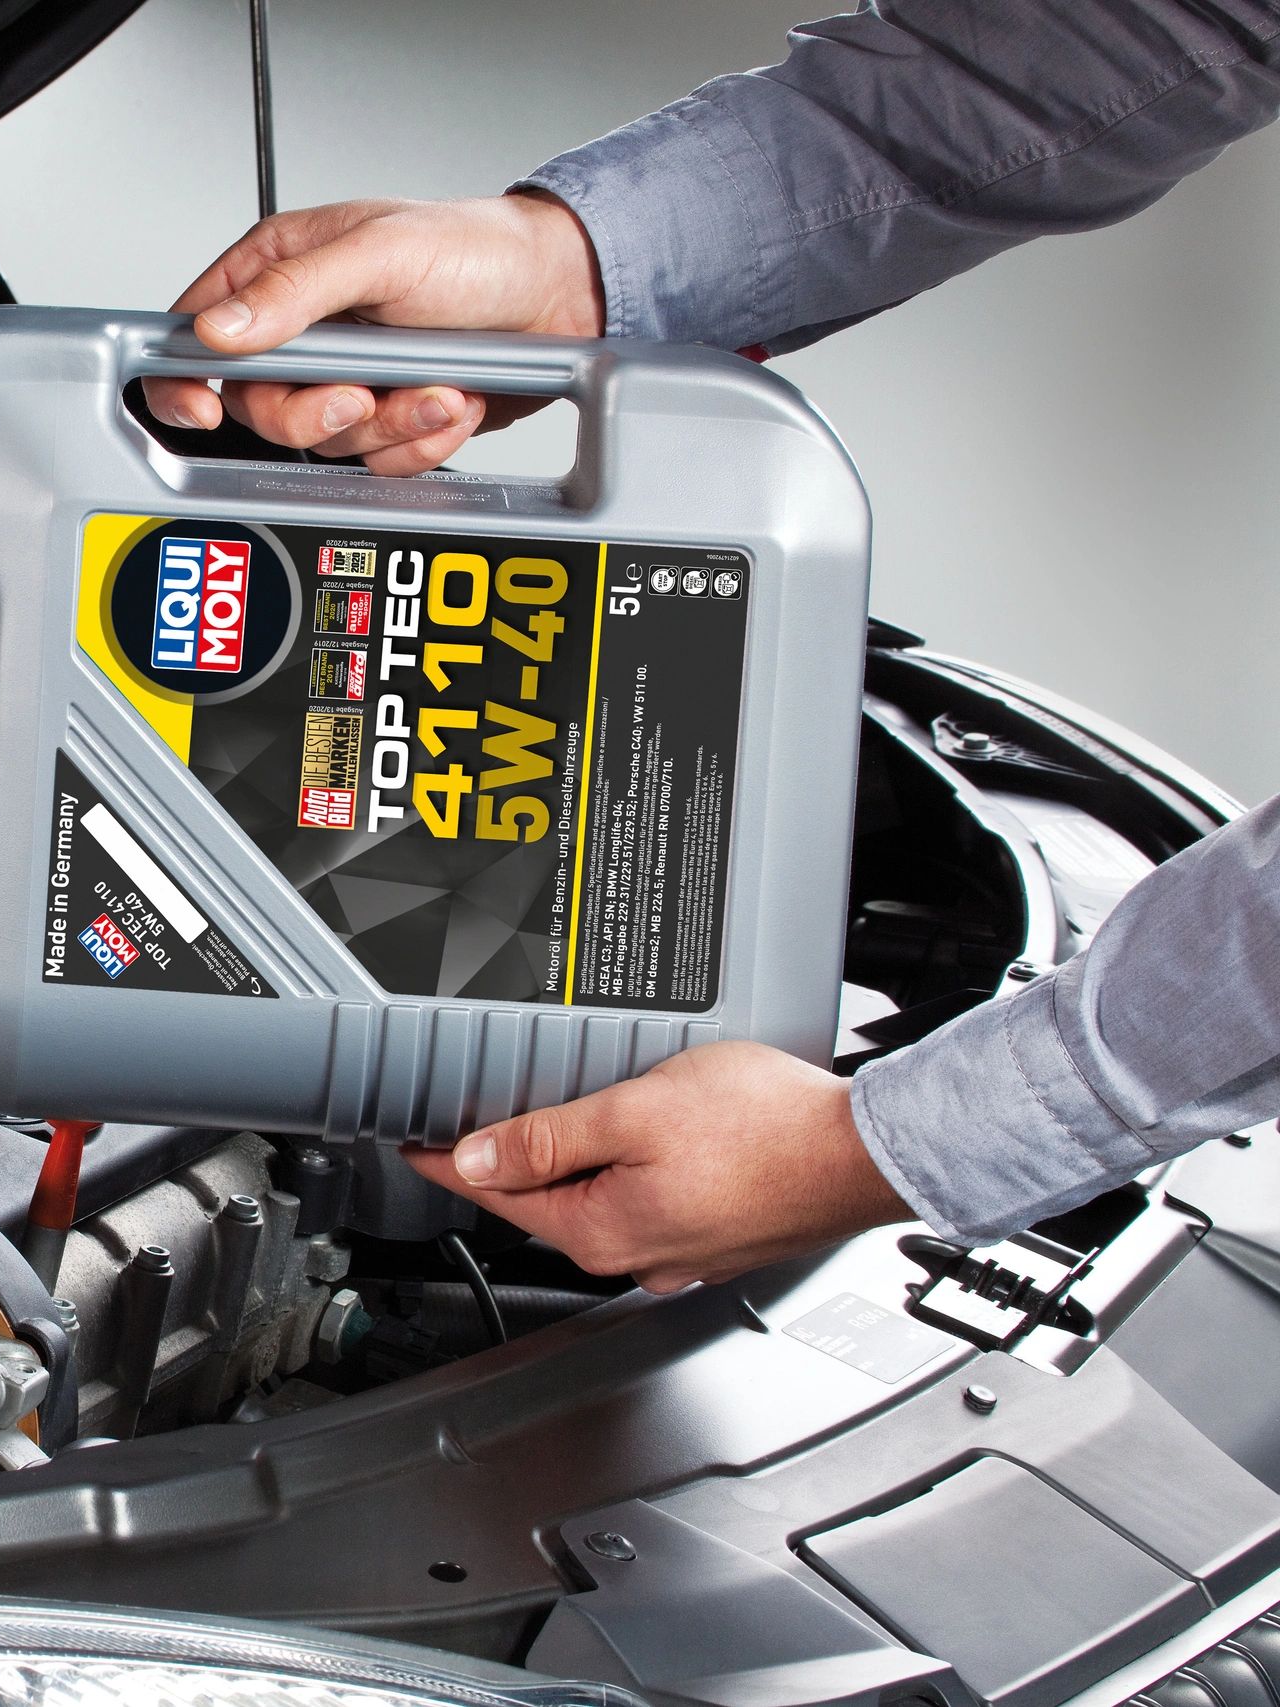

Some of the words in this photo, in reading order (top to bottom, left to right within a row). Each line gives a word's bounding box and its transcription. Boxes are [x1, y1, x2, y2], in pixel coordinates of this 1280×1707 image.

[349, 540, 377, 548] Ausgabe
[333, 552, 345, 572] TOP
[351, 553, 360, 573] 2020
[346, 582, 373, 590] Ausgabe
[157, 545, 204, 662] LIQUI
[200, 544, 246, 665] MOLY
[349, 602, 358, 632] auto
[380, 550, 425, 682] TEC
[342, 641, 368, 649] Ausgabe
[320, 652, 328, 676] BRAND
[352, 654, 365, 697] auto
[636, 664, 647, 681] 00.
[410, 552, 491, 840] 4110
[475, 556, 570, 844] 5W-40
[634, 684, 646, 703] 511
[599, 701, 608, 748] autorizzazioni
[633, 704, 644, 723] VW
[305, 715, 333, 763] BESTEN
[329, 717, 351, 788] MARKEN
[350, 718, 360, 754] KLASSEN
[631, 726, 644, 750] C40;
[348, 755, 358, 779] ALLEN
[368, 694, 413, 834] TOP
[595, 754, 604, 789] Specifiche
[644, 737, 654, 774] Aggregate,
[651, 751, 660, 783] gefordert
[303, 766, 329, 787] DIE
[347, 781, 356, 789] IN
[558, 722, 580, 830] Dieselfahrzeuge
[627, 752, 640, 797] Porsche
[659, 758, 674, 812] 0700/710.
[303, 789, 329, 826] Auto
[328, 792, 352, 824] Bild
[593, 794, 601, 827] approvals
[601, 779, 610, 824] autorizações:
[640, 791, 650, 827] Fahrzeuge
[608, 800, 625, 867] Longlife-04;
[643, 784, 657, 875] Originalersatzteilnummern
[658, 814, 669, 831] RN
[50, 792, 79, 888] Germany
[557, 833, 569, 858] und
[595, 830, 606, 879] Especificações
[637, 839, 645, 873] zusätzlich
[654, 833, 668, 876] Renault
[587, 841, 598, 888] Specifications
[617, 800, 638, 922] 229.31/229.51/229.52;
[94, 881, 125, 913] 4110
[551, 862, 567, 913] Benzin-
[606, 868, 618, 898] BMW
[634, 874, 643, 901] Produkt
[651, 879, 666, 912] 226.5;
[49, 894, 68, 913] in
[125, 893, 165, 937] 5W-40
[584, 893, 594, 928] Freigaben
[592, 884, 602, 934] autorizaciones
[604, 900, 617, 920] SN;
[633, 902, 641, 924] dieses
[638, 892, 649, 944] Spezifikationen
[122, 913, 148, 942] TEC
[550, 916, 563, 936] für
[602, 922, 614, 942] API
[650, 915, 661, 933] MB
[45, 918, 67, 977] Made
[81, 929, 123, 975] LIQUI
[94, 919, 136, 964] MOLY
[145, 943, 171, 970] TOP
[601, 944, 613, 962] C3;
[631, 925, 639, 958] empfiehlt
[647, 935, 661, 978] dexos2;
[225, 958, 235, 969] hier
[234, 968, 246, 980] Bitte
[235, 959, 250, 976] Please
[545, 940, 561, 991] Motoröl
[579, 942, 589, 994] Spezifikationen
[586, 939, 597, 995] Especificaciones
[612, 924, 628, 996] MB-Freigabe
[628, 958, 636, 977] MOLY
[636, 944, 645, 974] folgende
[214, 970, 233, 991] Nächster
[227, 974, 238, 987] Next
[598, 964, 611, 996] ACEA
[627, 978, 635, 997] LIQUI
[645, 980, 656, 998] GM
